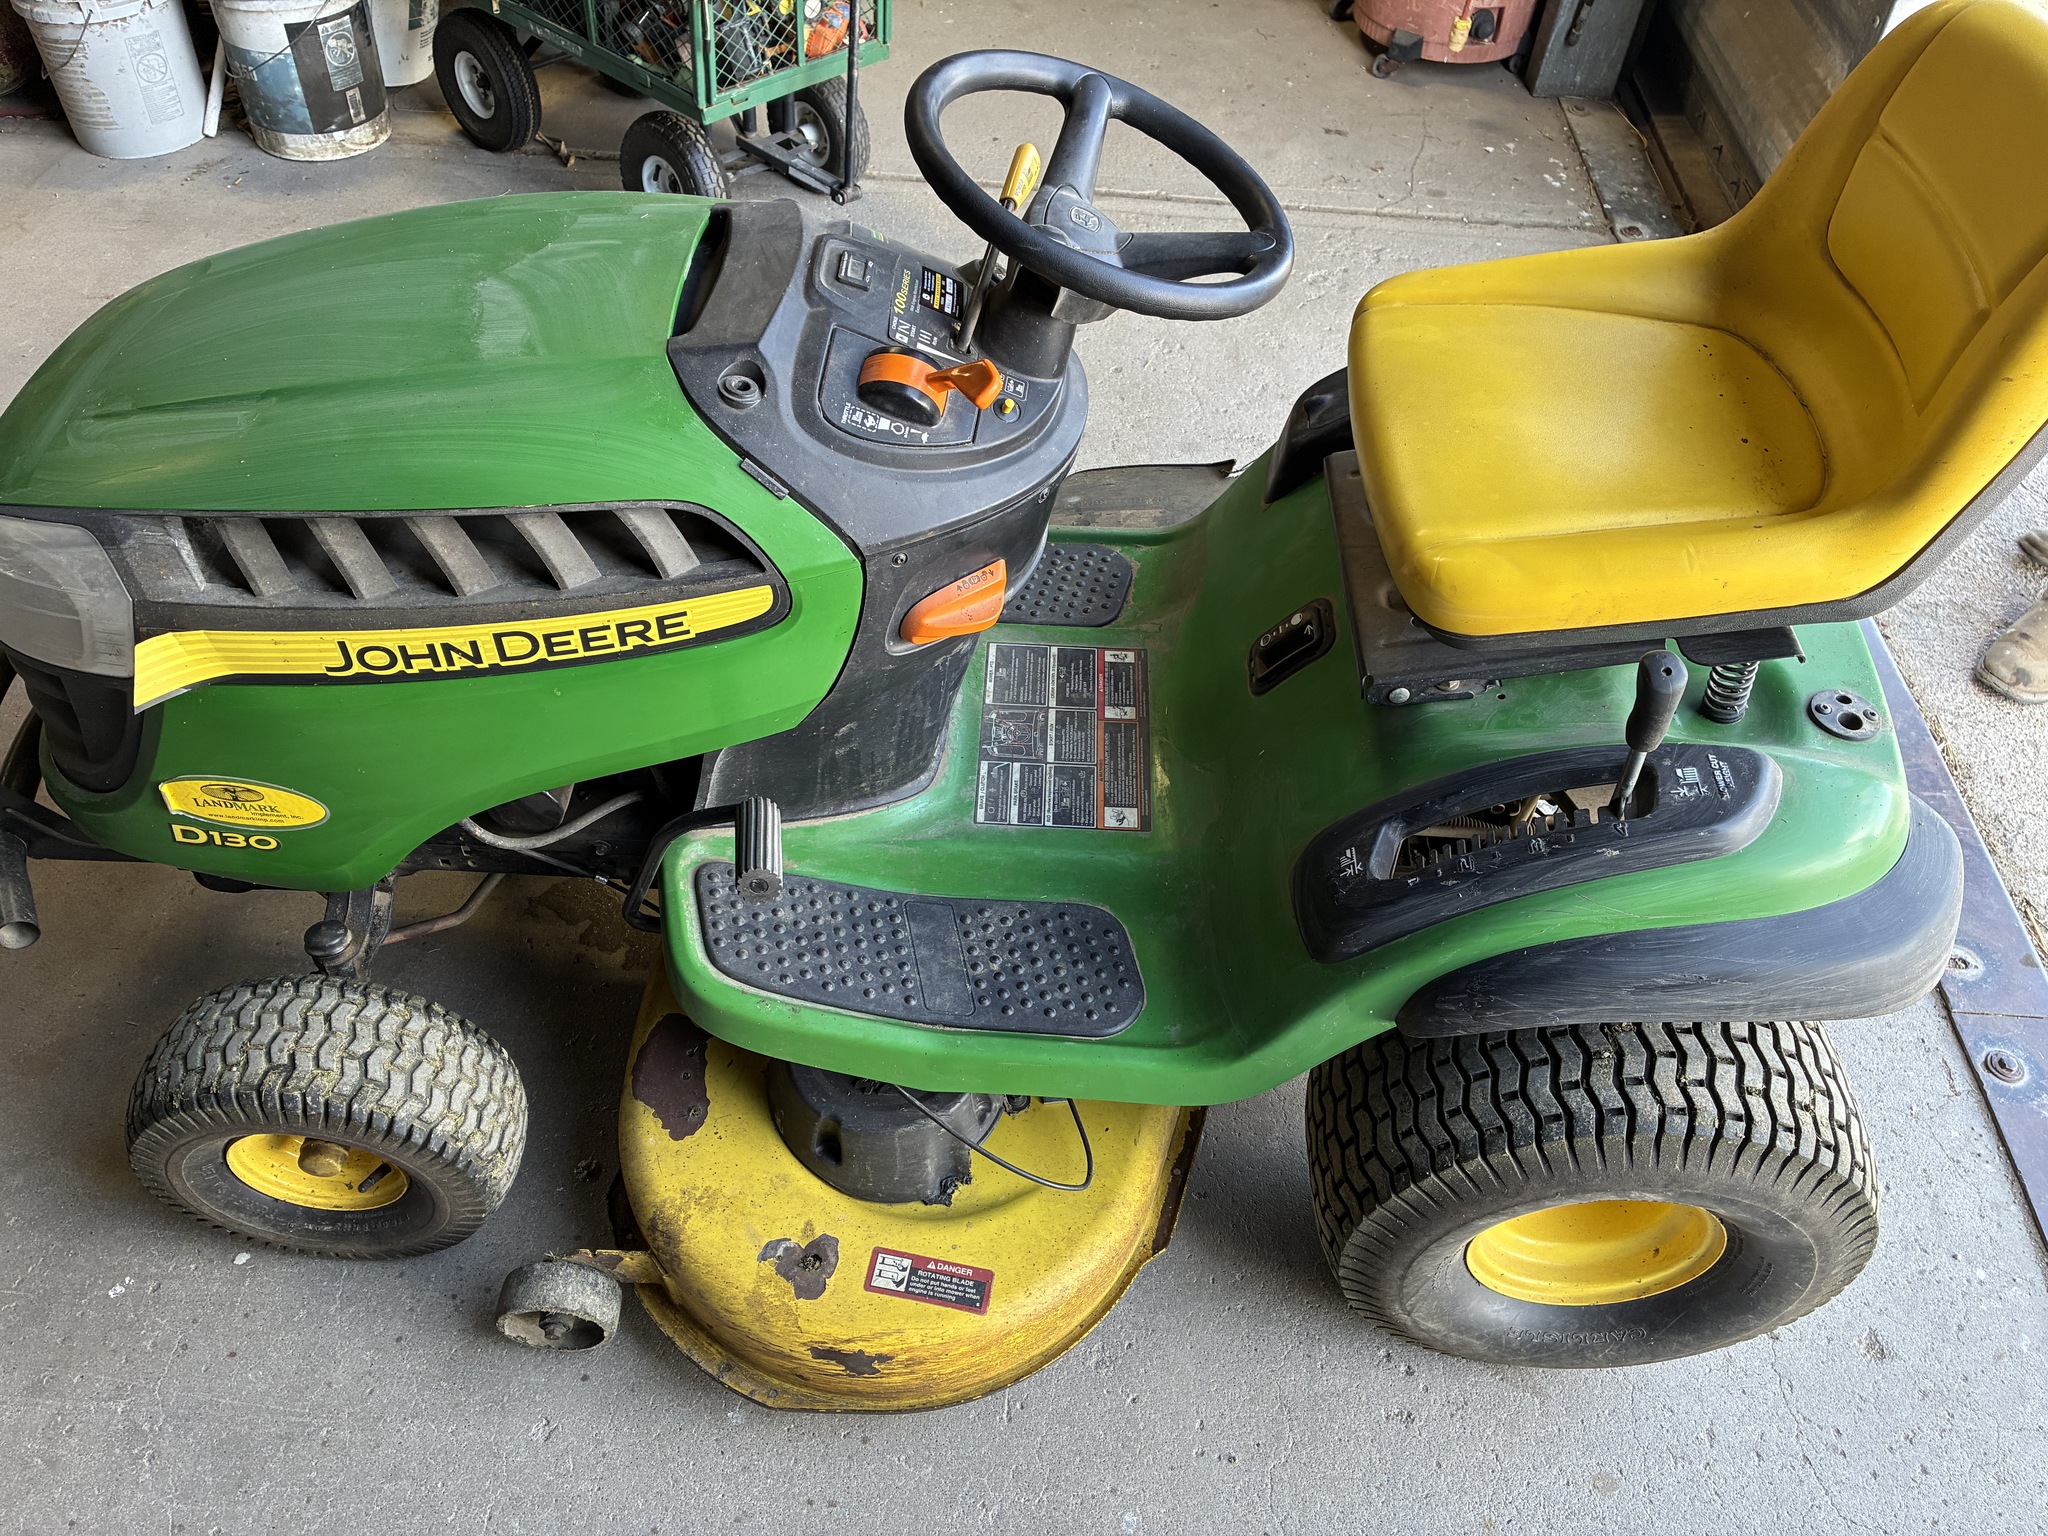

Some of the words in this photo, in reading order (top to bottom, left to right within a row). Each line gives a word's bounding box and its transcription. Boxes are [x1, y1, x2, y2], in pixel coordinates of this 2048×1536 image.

[841, 402, 851, 424] THROTTLE
[325, 640, 482, 672] JOHN
[492, 611, 691, 661] DEERE
[1708, 754, 1719, 769] CUT
[171, 824, 278, 850] D130
[937, 1263, 973, 1276] DANGER
[918, 1270, 951, 1281] ROTATING
[952, 1278, 974, 1286] BLADE
[940, 1280, 957, 1289] hands
[934, 1292, 956, 1301] running
[946, 1288, 964, 1296] mower
[1507, 1327, 1646, 1344] CARLISLE
